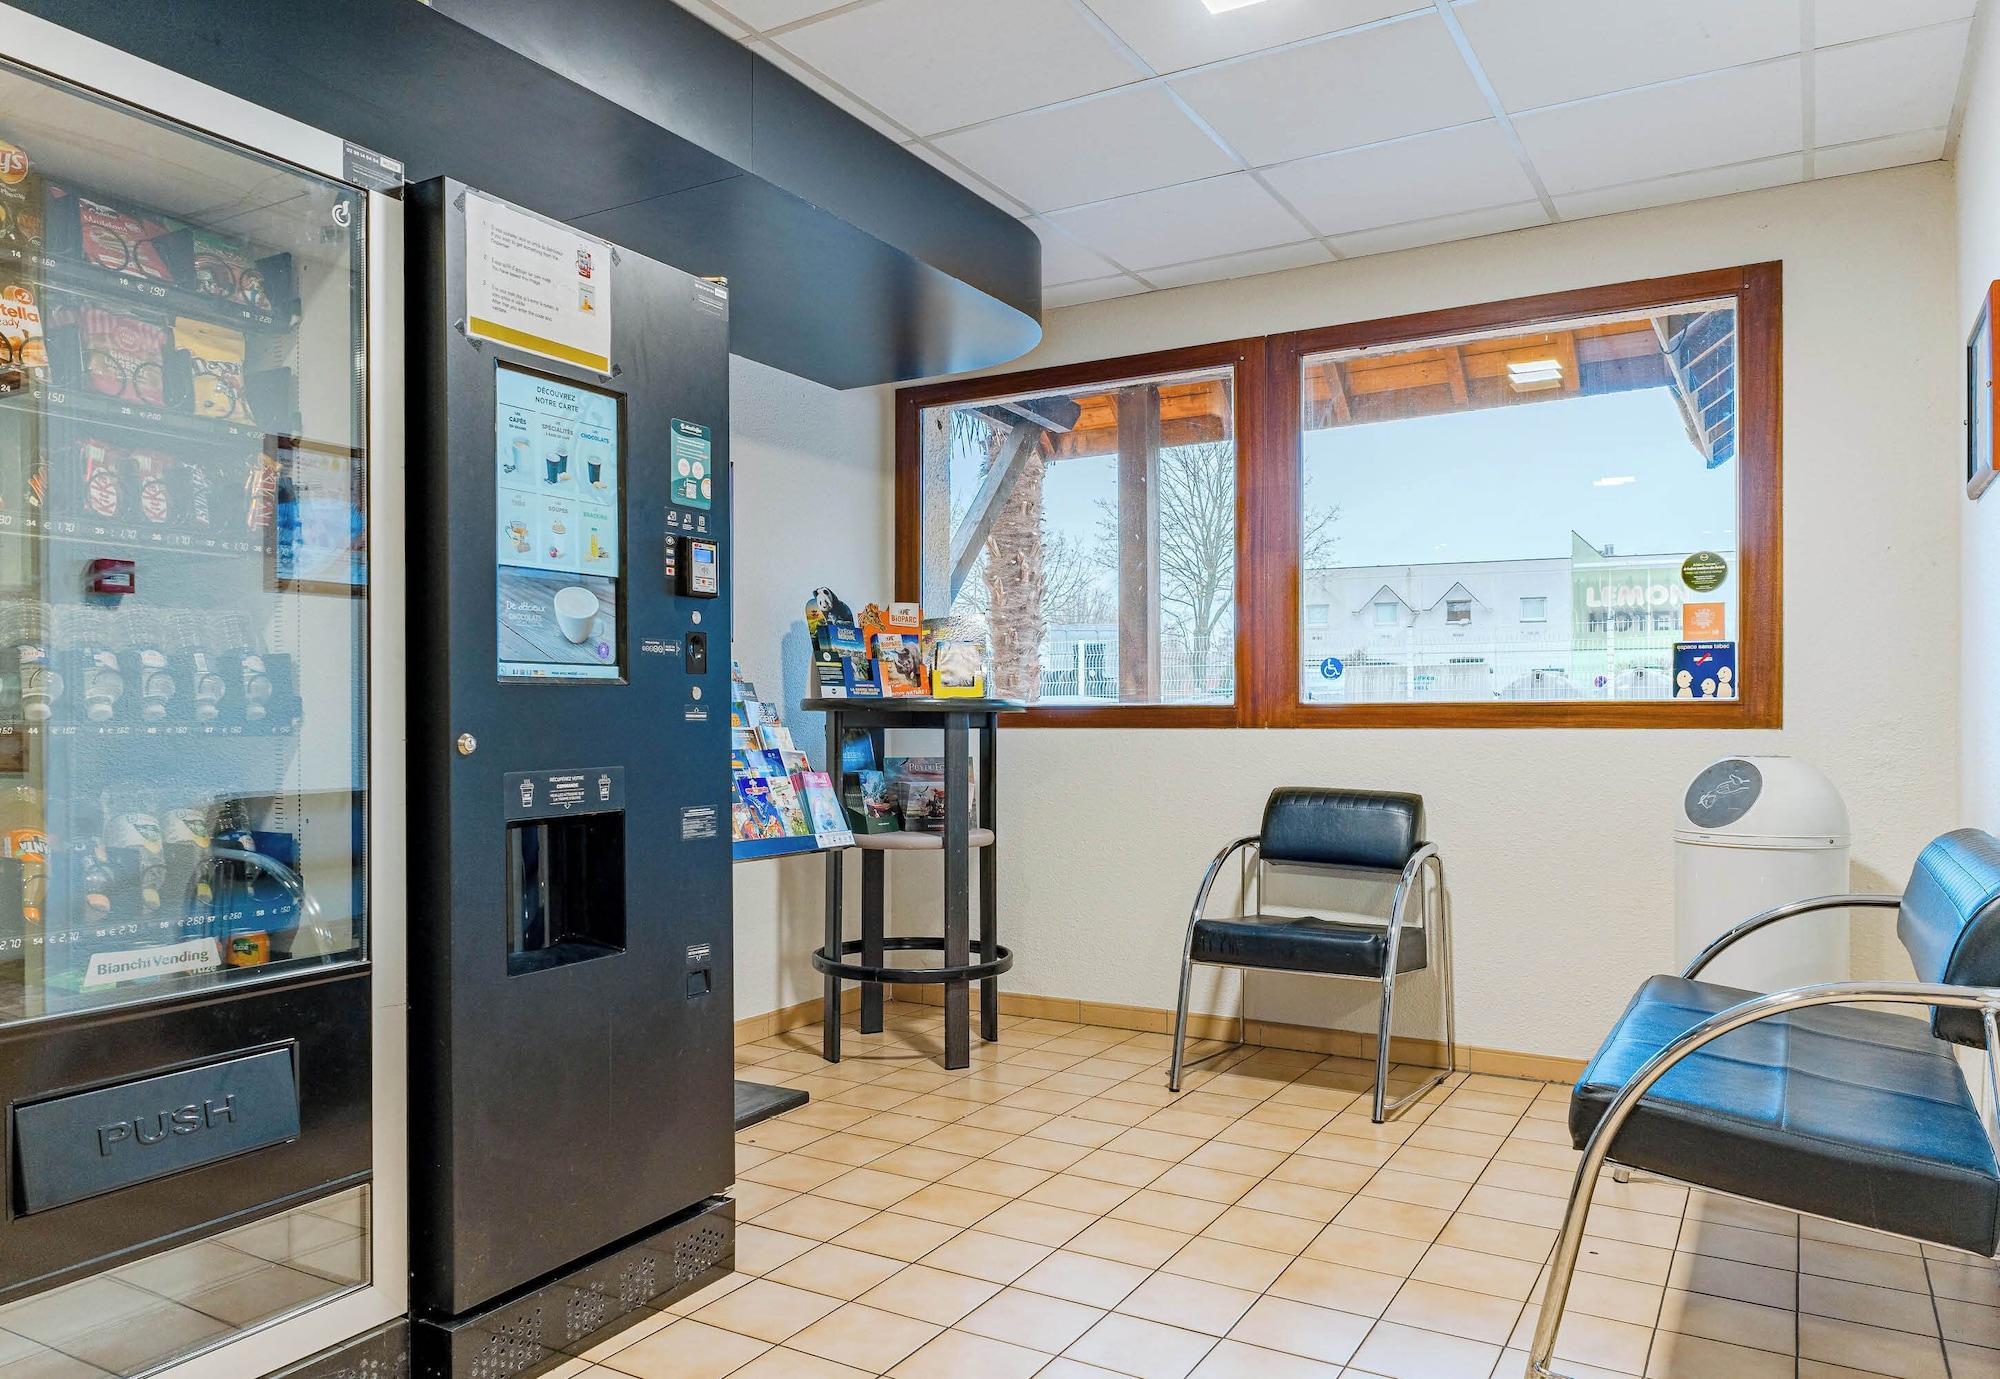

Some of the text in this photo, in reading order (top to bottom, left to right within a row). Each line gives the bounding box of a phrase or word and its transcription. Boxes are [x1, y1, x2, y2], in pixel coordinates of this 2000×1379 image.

[0, 304, 39, 323] tella
[537, 385, 576, 402] DÉCOUVREZ
[535, 396, 579, 413] NOTRE CARTE
[1587, 585, 1688, 608] LEMON
[97, 948, 210, 976] Bianchi Vending
[97, 1094, 238, 1157] PUSH
